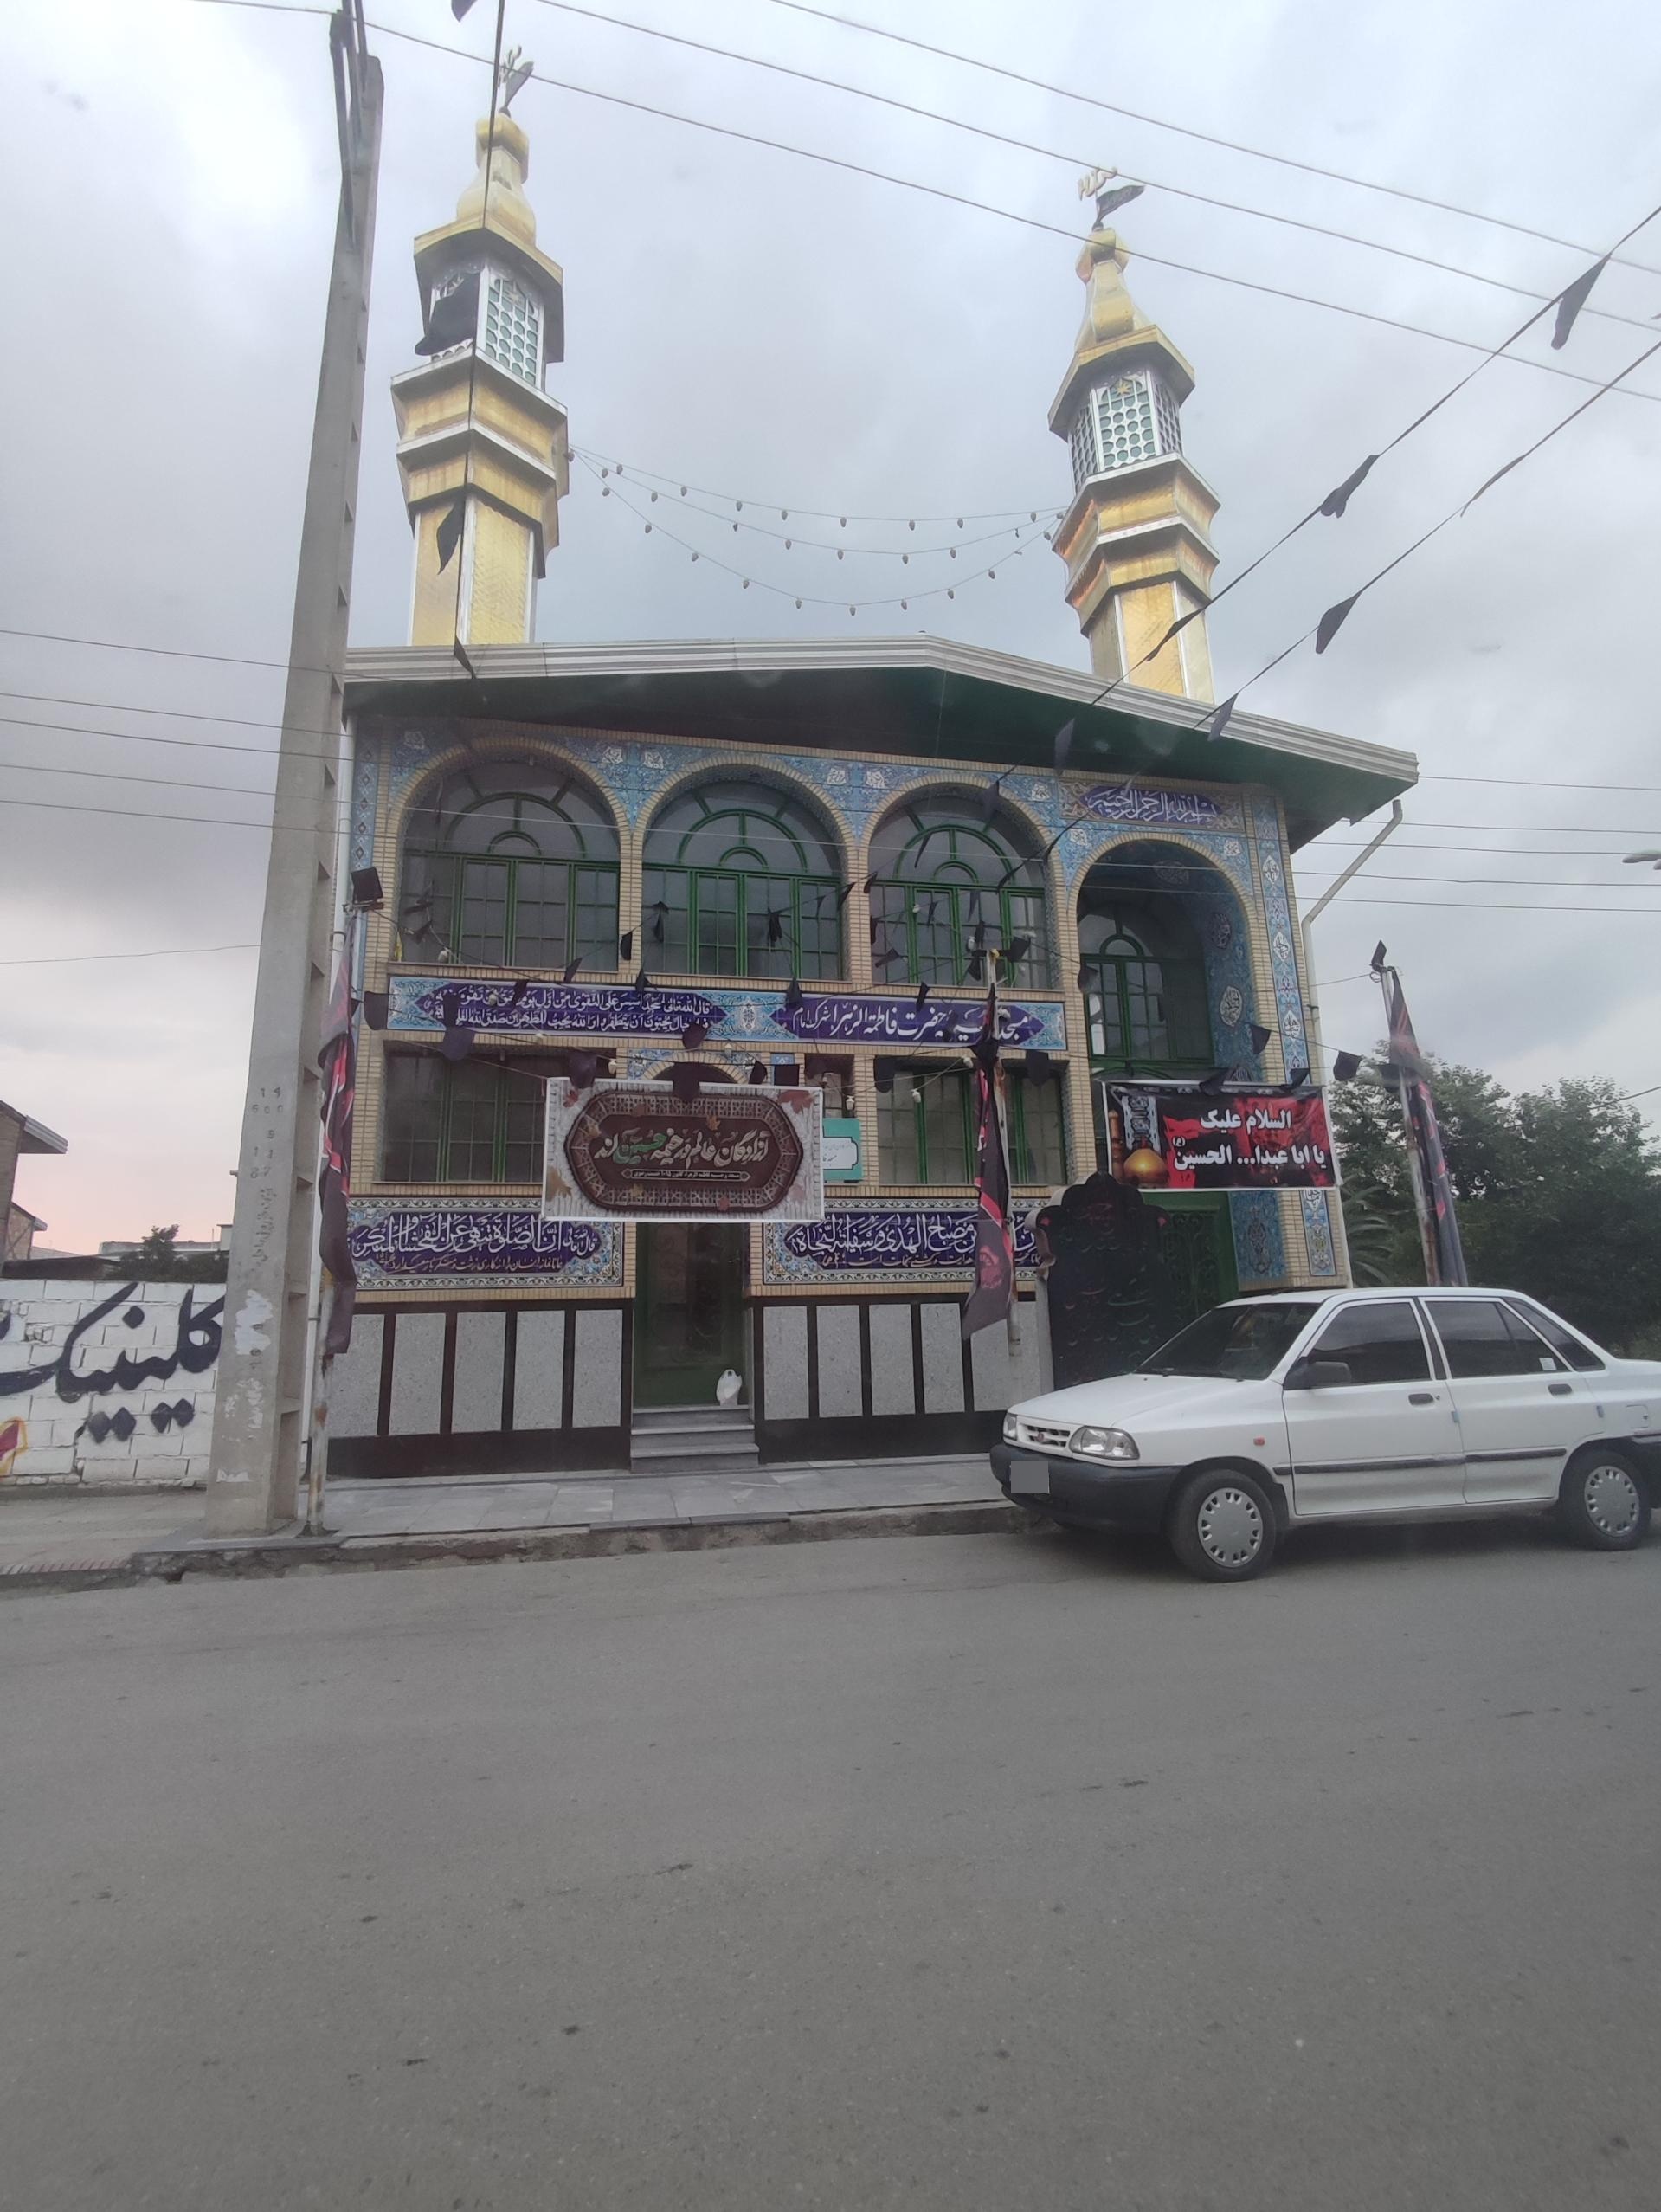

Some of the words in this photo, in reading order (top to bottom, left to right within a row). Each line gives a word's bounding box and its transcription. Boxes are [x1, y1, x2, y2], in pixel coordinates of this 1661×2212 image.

[1200, 1108, 1242, 1134] علیک
[1246, 1107, 1291, 1135] السلام
[1174, 1145, 1233, 1171] الحسین
[1293, 1145, 1310, 1168] ابا
[1313, 1145, 1327, 1170] یا
